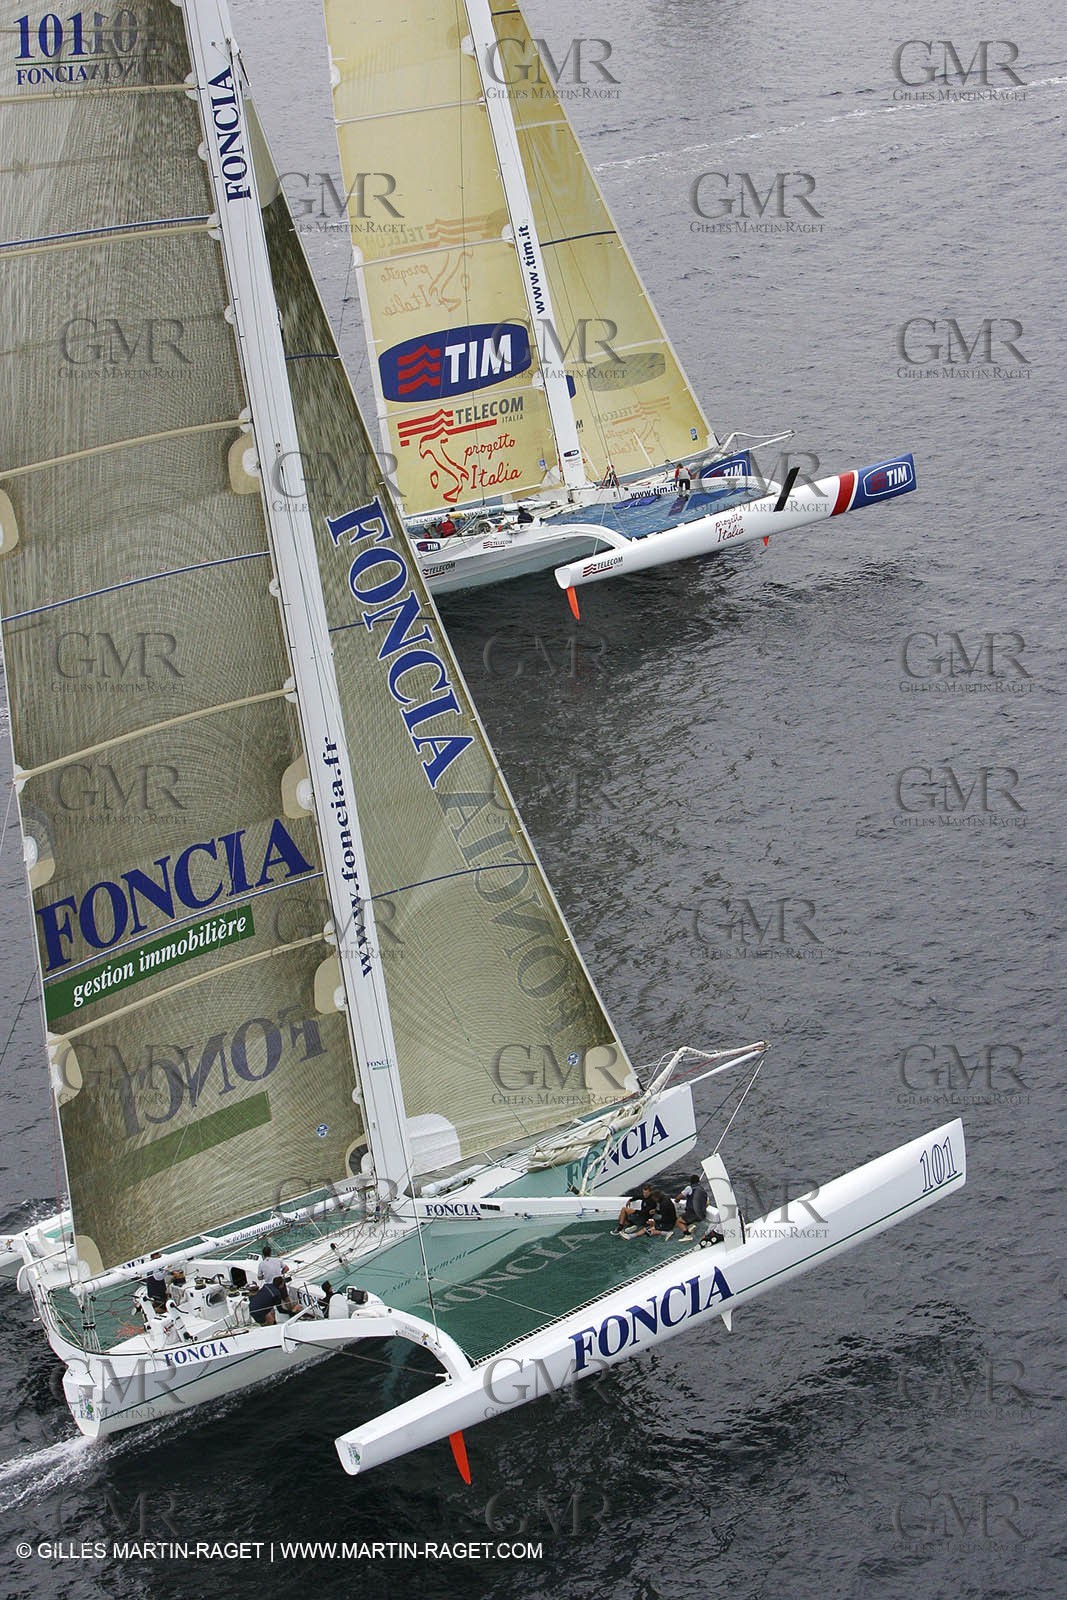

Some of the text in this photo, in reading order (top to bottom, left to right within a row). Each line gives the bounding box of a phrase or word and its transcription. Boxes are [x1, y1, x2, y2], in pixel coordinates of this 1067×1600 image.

[13, 11, 87, 59] 101
[16, 66, 88, 86] FONCIA
[207, 65, 253, 203] FONCIA
[518, 224, 546, 314] www.tim.it
[445, 333, 513, 384] TIM
[455, 396, 524, 424] TELECOM
[501, 413, 524, 423] ITALIA
[464, 433, 516, 466] progetto
[470, 462, 522, 490] Italia
[723, 463, 743, 477] TIM
[886, 464, 908, 486] TIM
[630, 482, 677, 499] www.tim.it
[427, 543, 440, 551] TIM
[429, 561, 456, 575] TELECOM
[596, 555, 624, 571] TELECOM
[325, 496, 475, 790] FONCIA
[321, 736, 373, 977] www.foncia.fr
[35, 818, 316, 973] FONCIA
[72, 912, 247, 1008] gestion immobilière
[920, 1136, 957, 1193] 101
[425, 1202, 481, 1217] FONCIA
[568, 1266, 735, 1374] FONCIA
[164, 1341, 229, 1367] FONCIA
